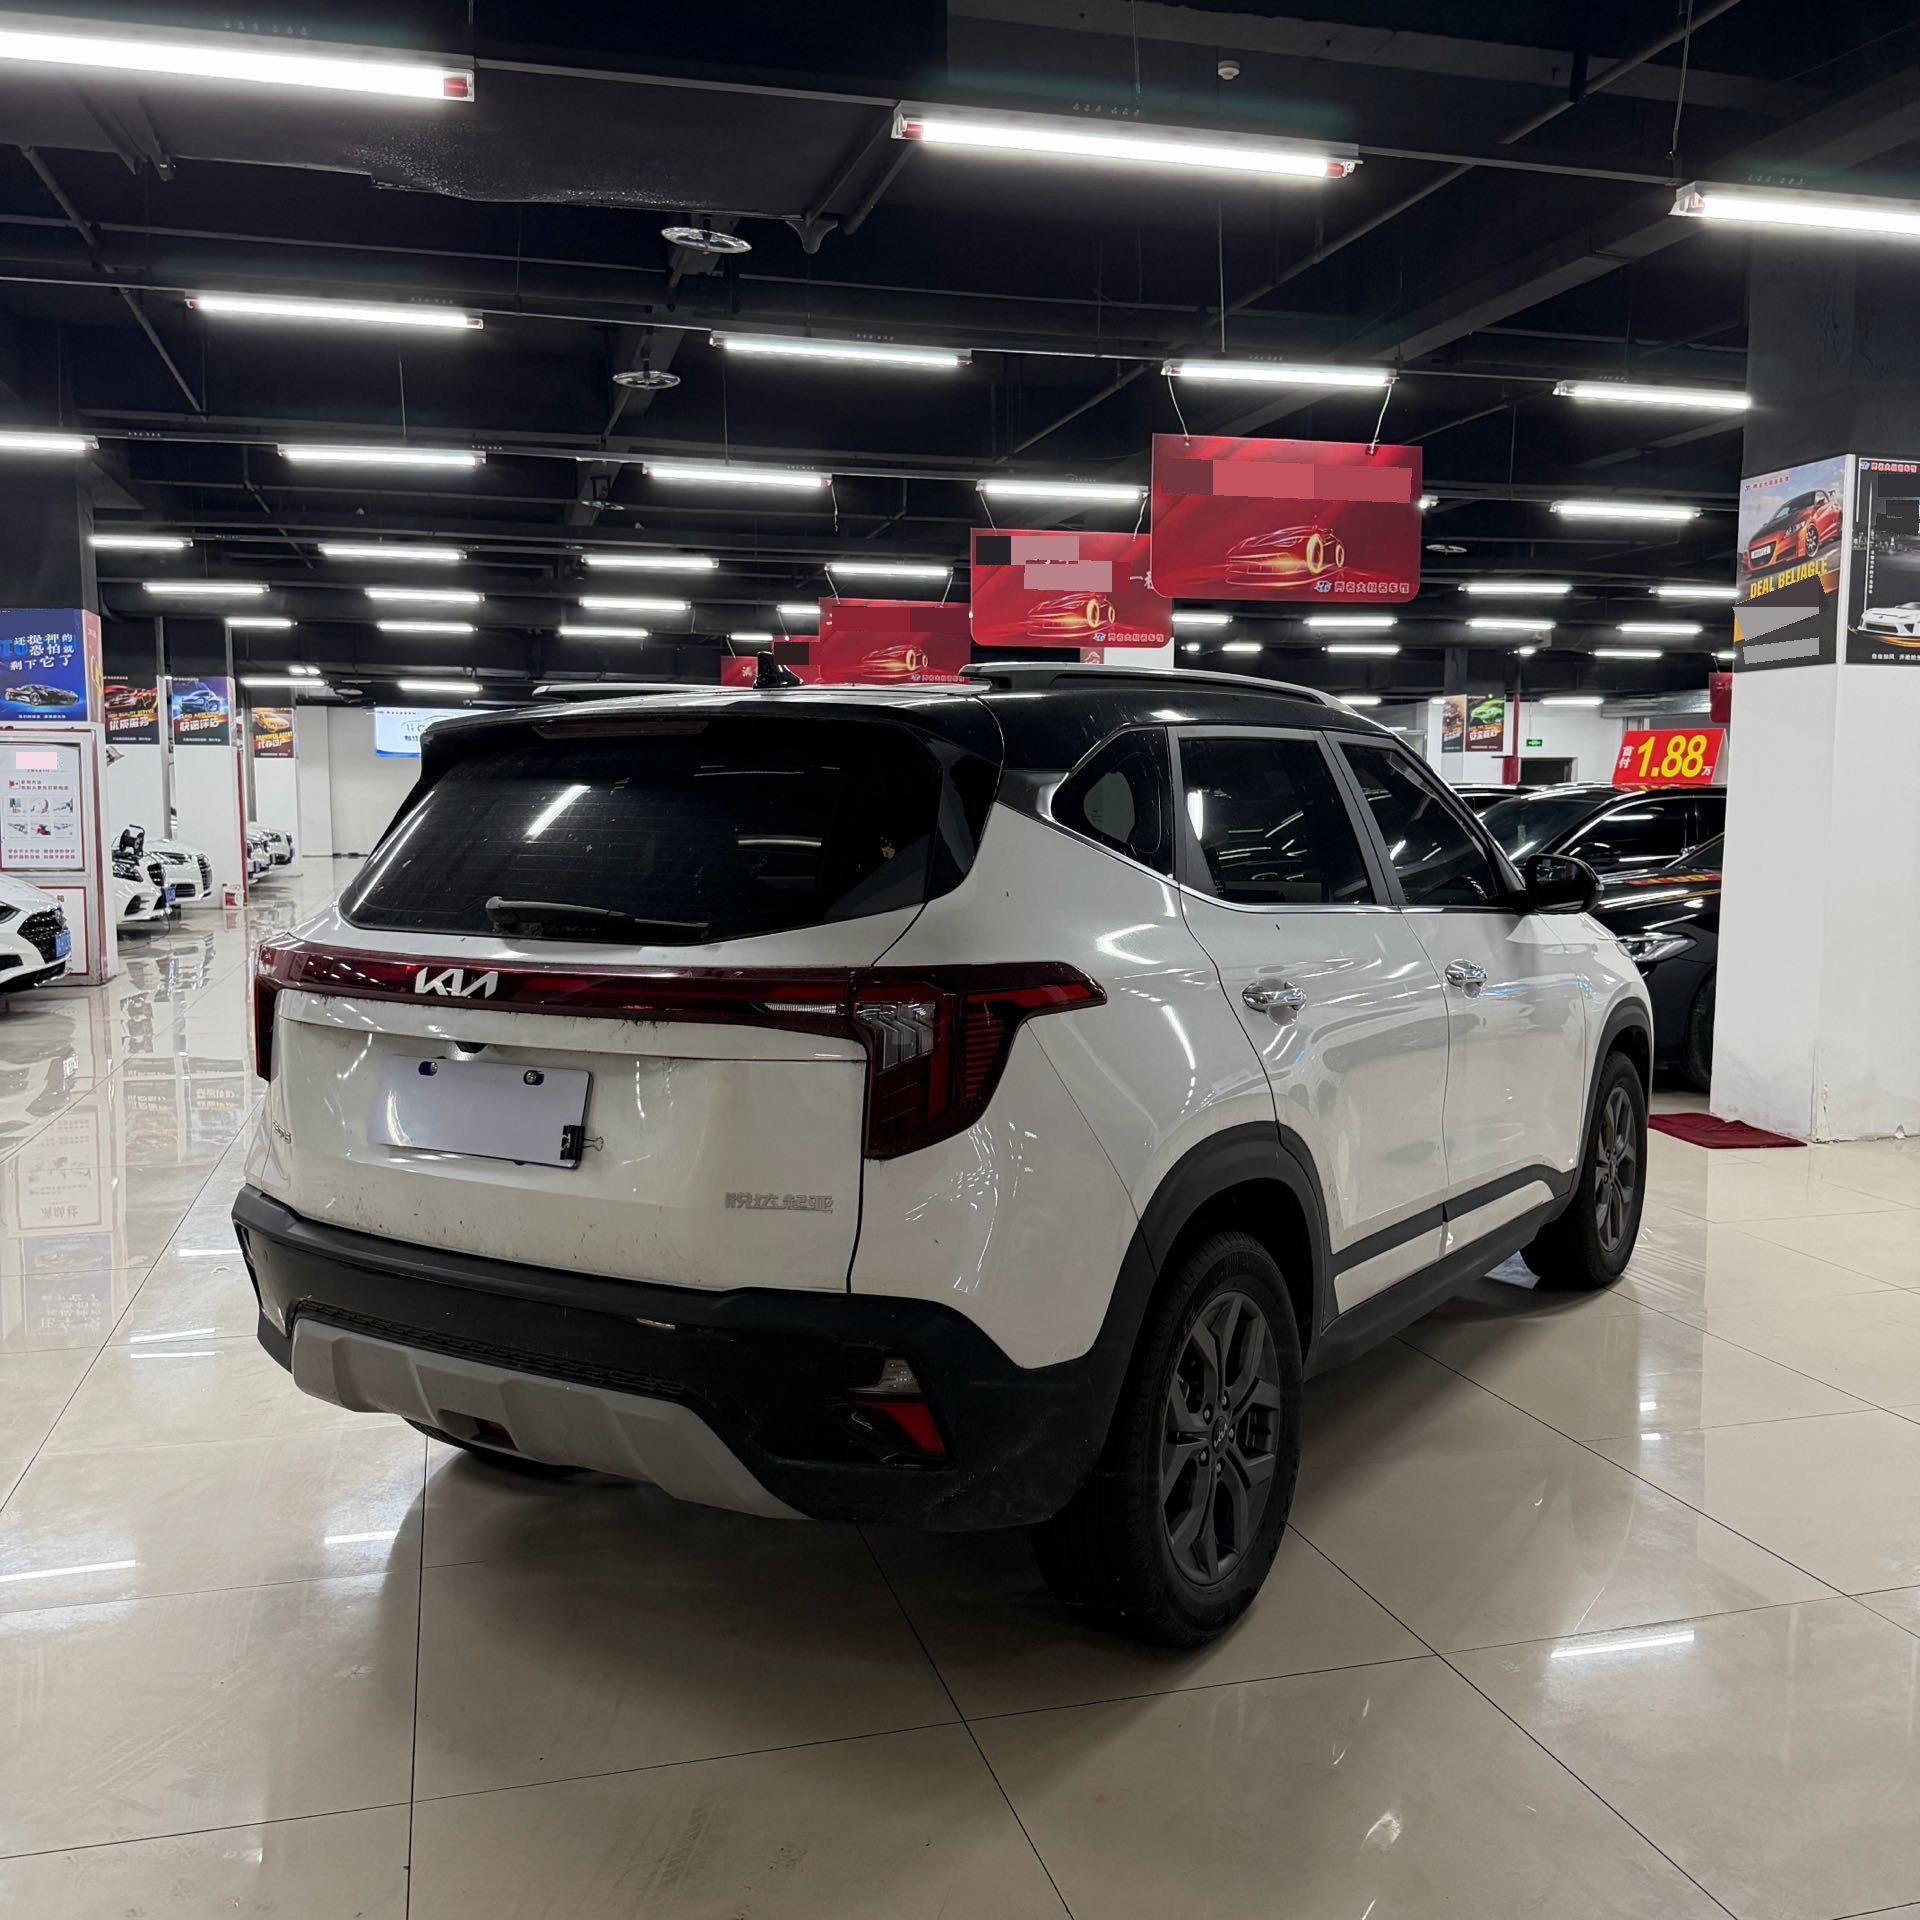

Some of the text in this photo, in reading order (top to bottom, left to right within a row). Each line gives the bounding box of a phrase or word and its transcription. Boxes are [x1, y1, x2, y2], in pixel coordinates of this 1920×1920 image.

[1749, 576, 1775, 599] DEAL
[14, 633, 73, 646] 还提神的
[29, 643, 75, 656] 恐怕就
[10, 654, 72, 671] 剩下它了
[1619, 734, 1713, 778] 首付 1.88 万
[414, 967, 499, 999] KIA
